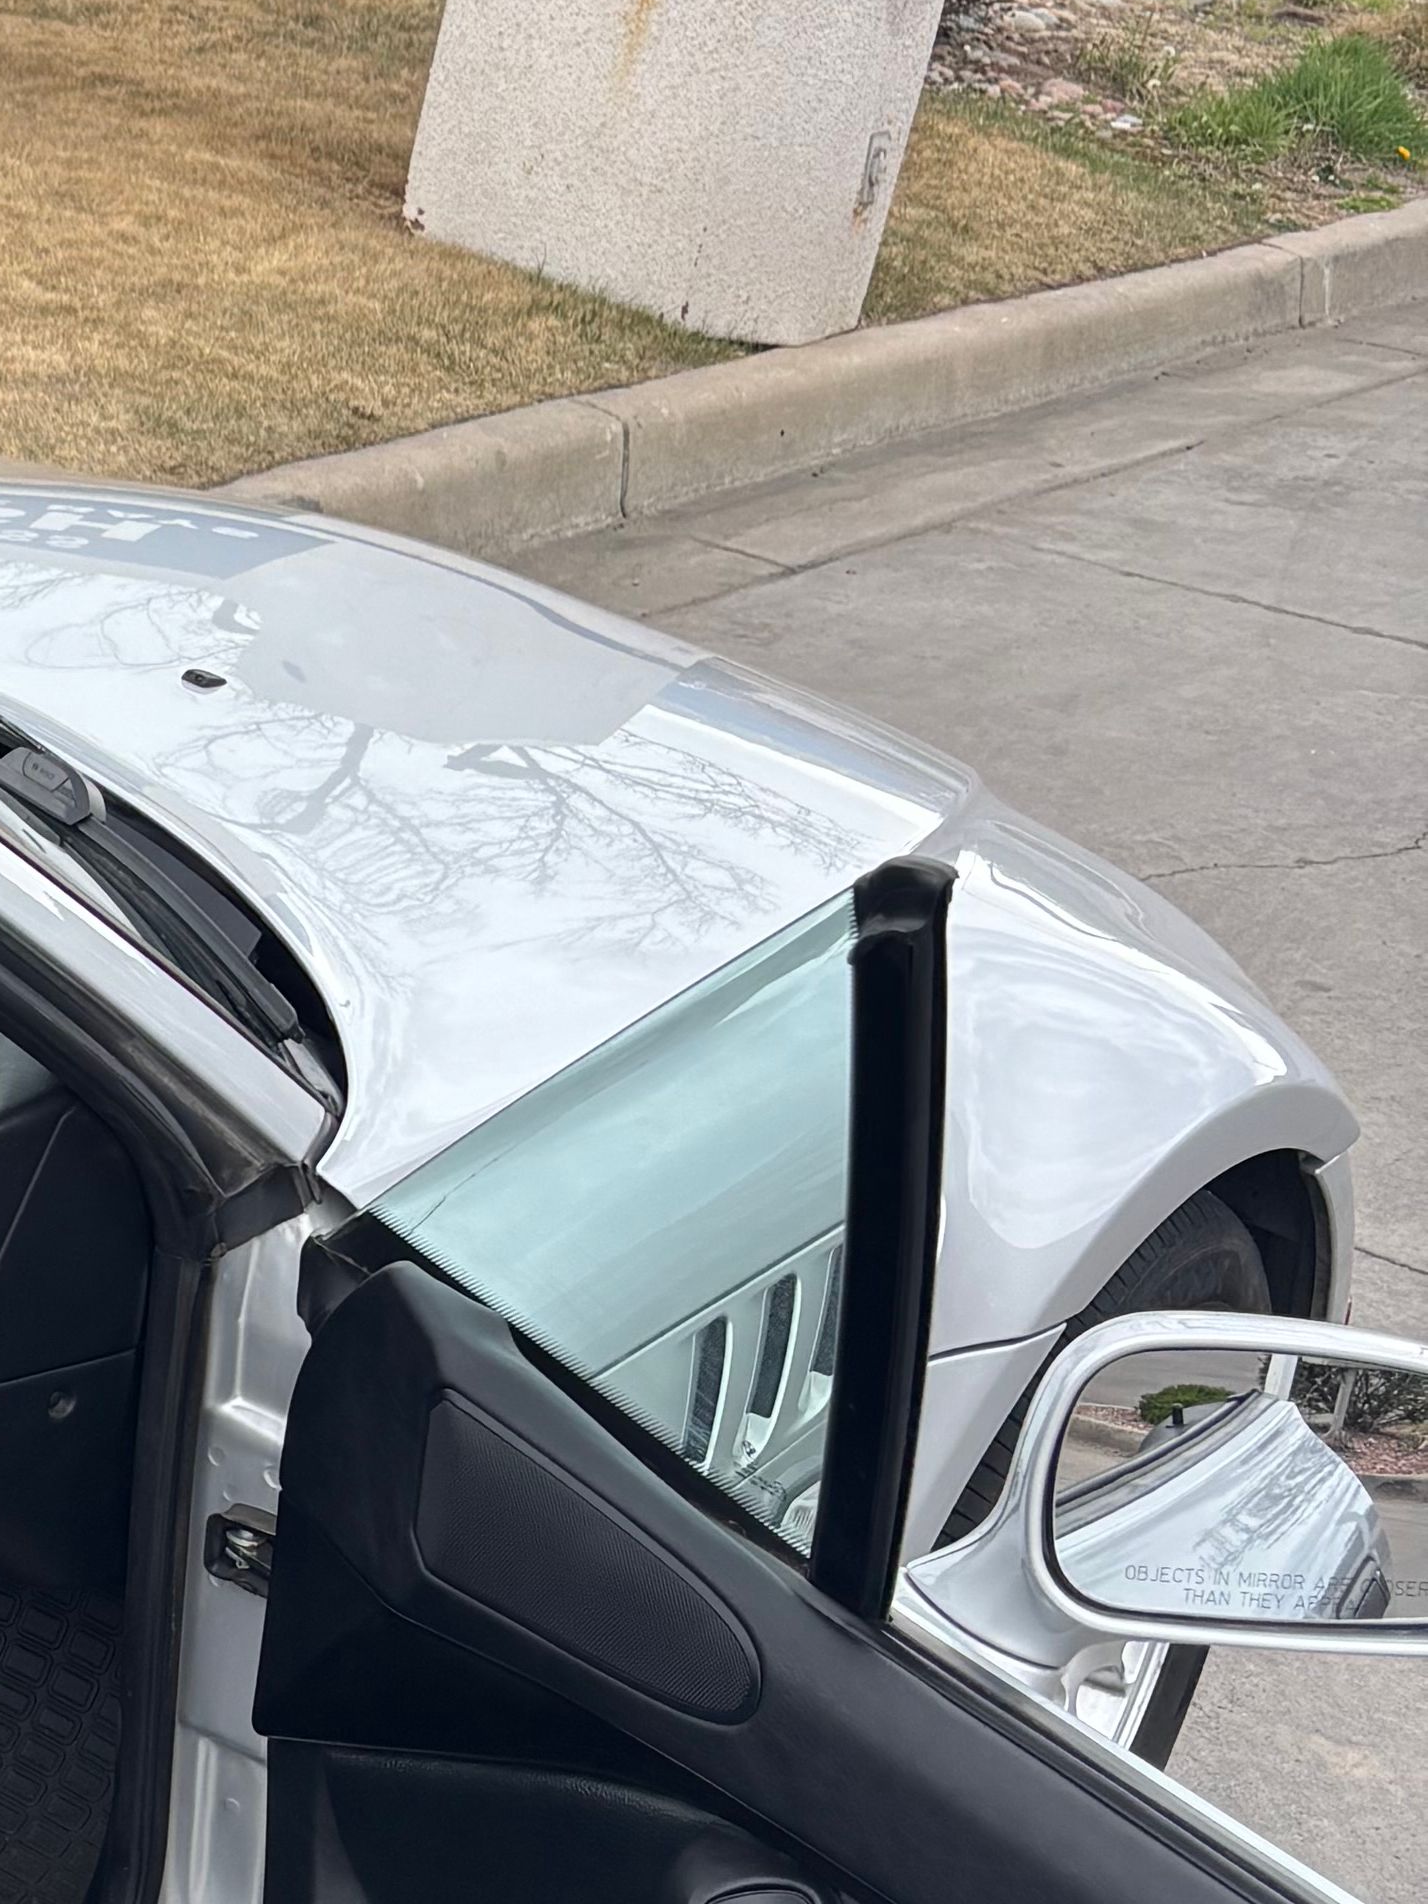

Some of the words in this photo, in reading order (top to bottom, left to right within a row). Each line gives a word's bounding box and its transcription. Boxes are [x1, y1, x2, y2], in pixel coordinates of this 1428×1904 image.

[1123, 1564, 1205, 1584] OBJECTS
[1212, 1570, 1231, 1586] IN
[1238, 1571, 1306, 1590] MIRROR
[1183, 1588, 1231, 1606] THAN
[1240, 1591, 1286, 1610] THEY
